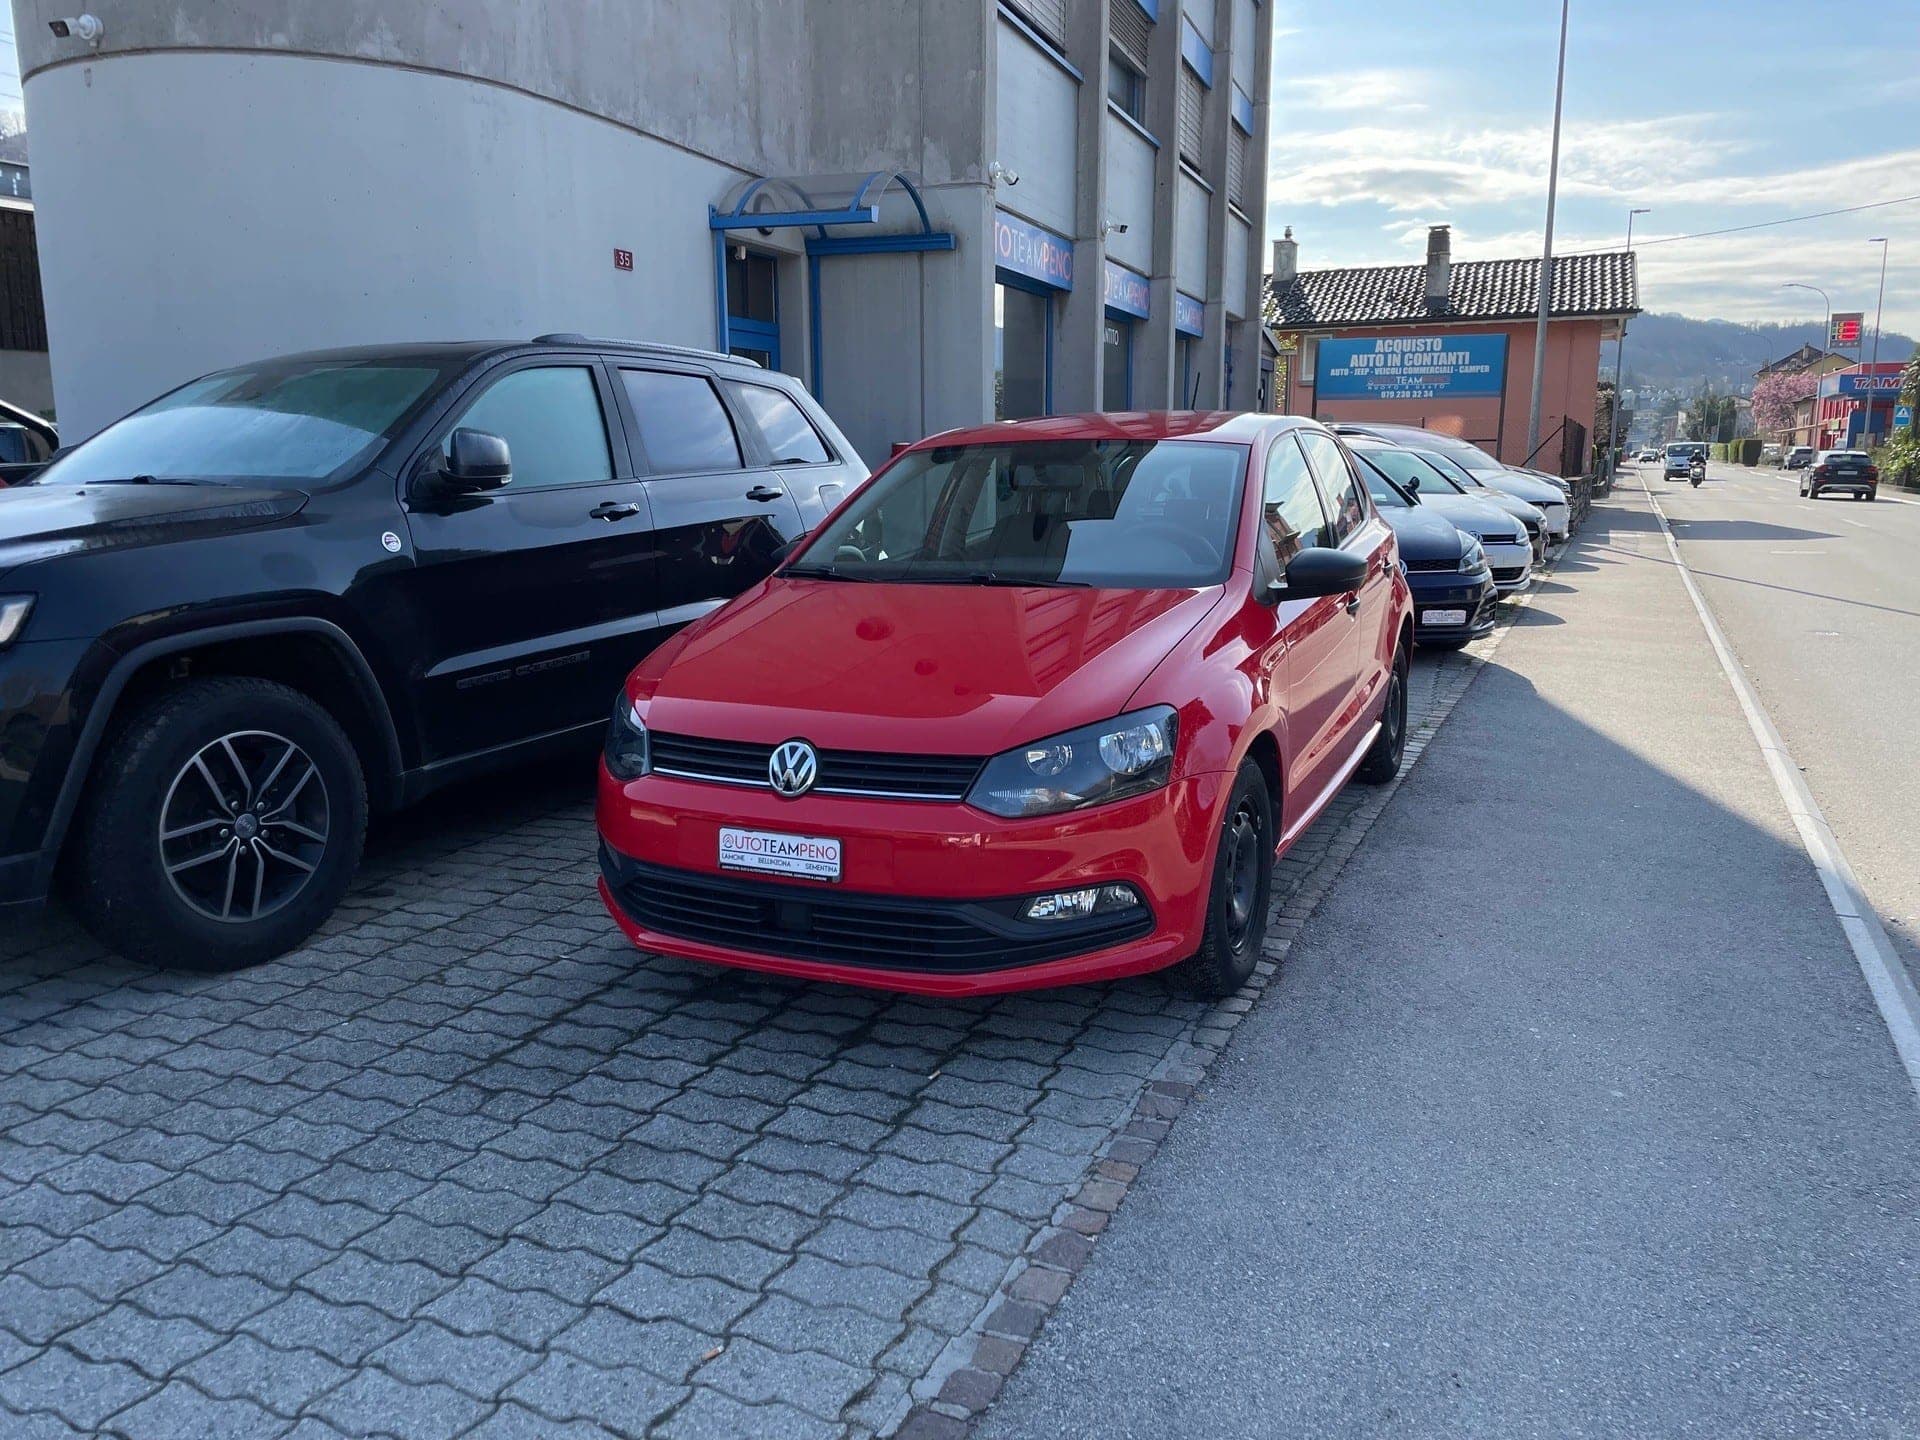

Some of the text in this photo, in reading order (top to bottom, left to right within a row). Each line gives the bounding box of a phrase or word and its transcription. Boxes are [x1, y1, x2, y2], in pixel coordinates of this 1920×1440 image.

[618, 251, 630, 266] 35
[1375, 338, 1442, 353] ACQUISTO
[1350, 352, 1470, 367] AUTO IN CONTANTI
[1330, 365, 1490, 376] AUTO JEEP VEICOLI COMMERCIALI CAMPER
[722, 852, 745, 861] LAMONE
[758, 857, 791, 867] BELLINZONA
[805, 863, 838, 873] SEMENTINA
